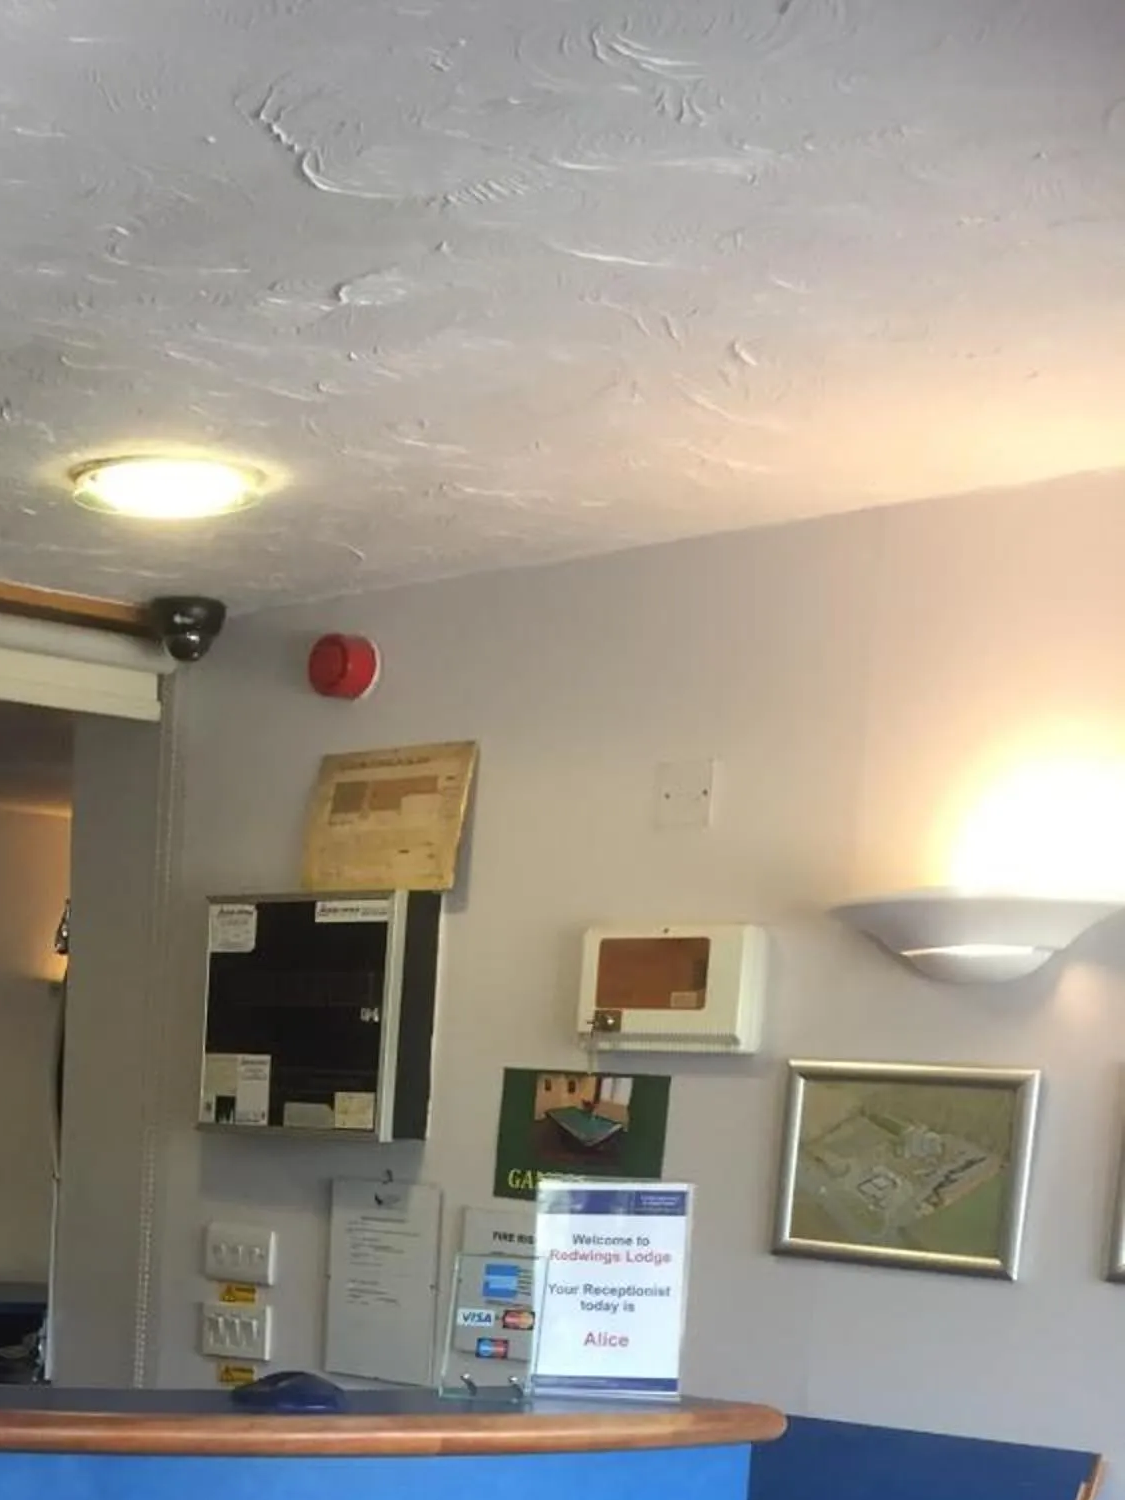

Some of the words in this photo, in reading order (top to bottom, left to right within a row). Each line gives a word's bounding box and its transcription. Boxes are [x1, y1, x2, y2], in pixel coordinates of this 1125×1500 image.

[572, 1234, 633, 1246] Welcome
[636, 1236, 650, 1247] to
[549, 1249, 620, 1265] Redwings
[626, 1251, 672, 1267] Lodge
[548, 1283, 579, 1294] Your
[583, 1283, 671, 1298] Receptionist
[580, 1300, 619, 1315] today
[622, 1300, 635, 1312] is
[462, 1311, 492, 1323] VISA
[583, 1331, 630, 1347] Alice
